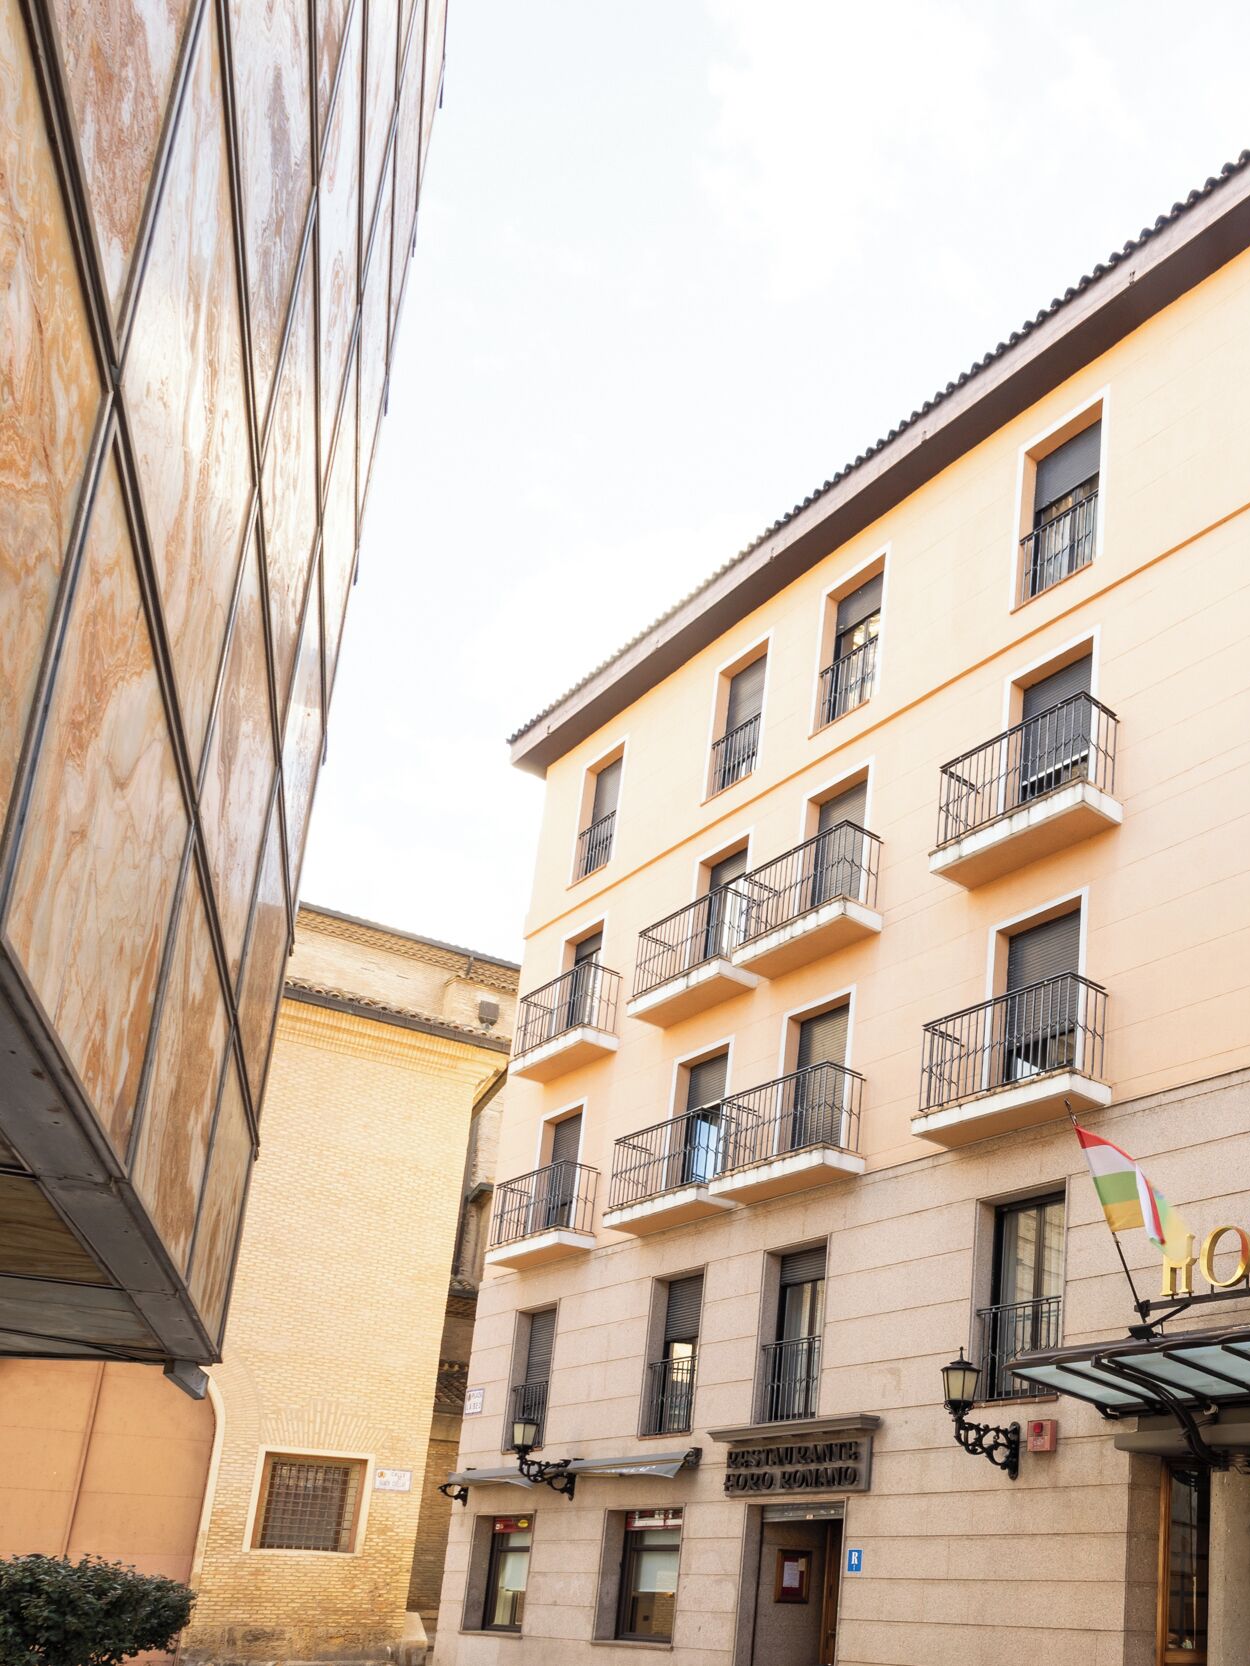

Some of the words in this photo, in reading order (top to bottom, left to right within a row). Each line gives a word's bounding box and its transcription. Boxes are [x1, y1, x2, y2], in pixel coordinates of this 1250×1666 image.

[727, 1441, 860, 1468] RESTAURANTE
[724, 1471, 775, 1491] FORO
[779, 1466, 858, 1489] ROMANO
[851, 1552, 858, 1564] R
